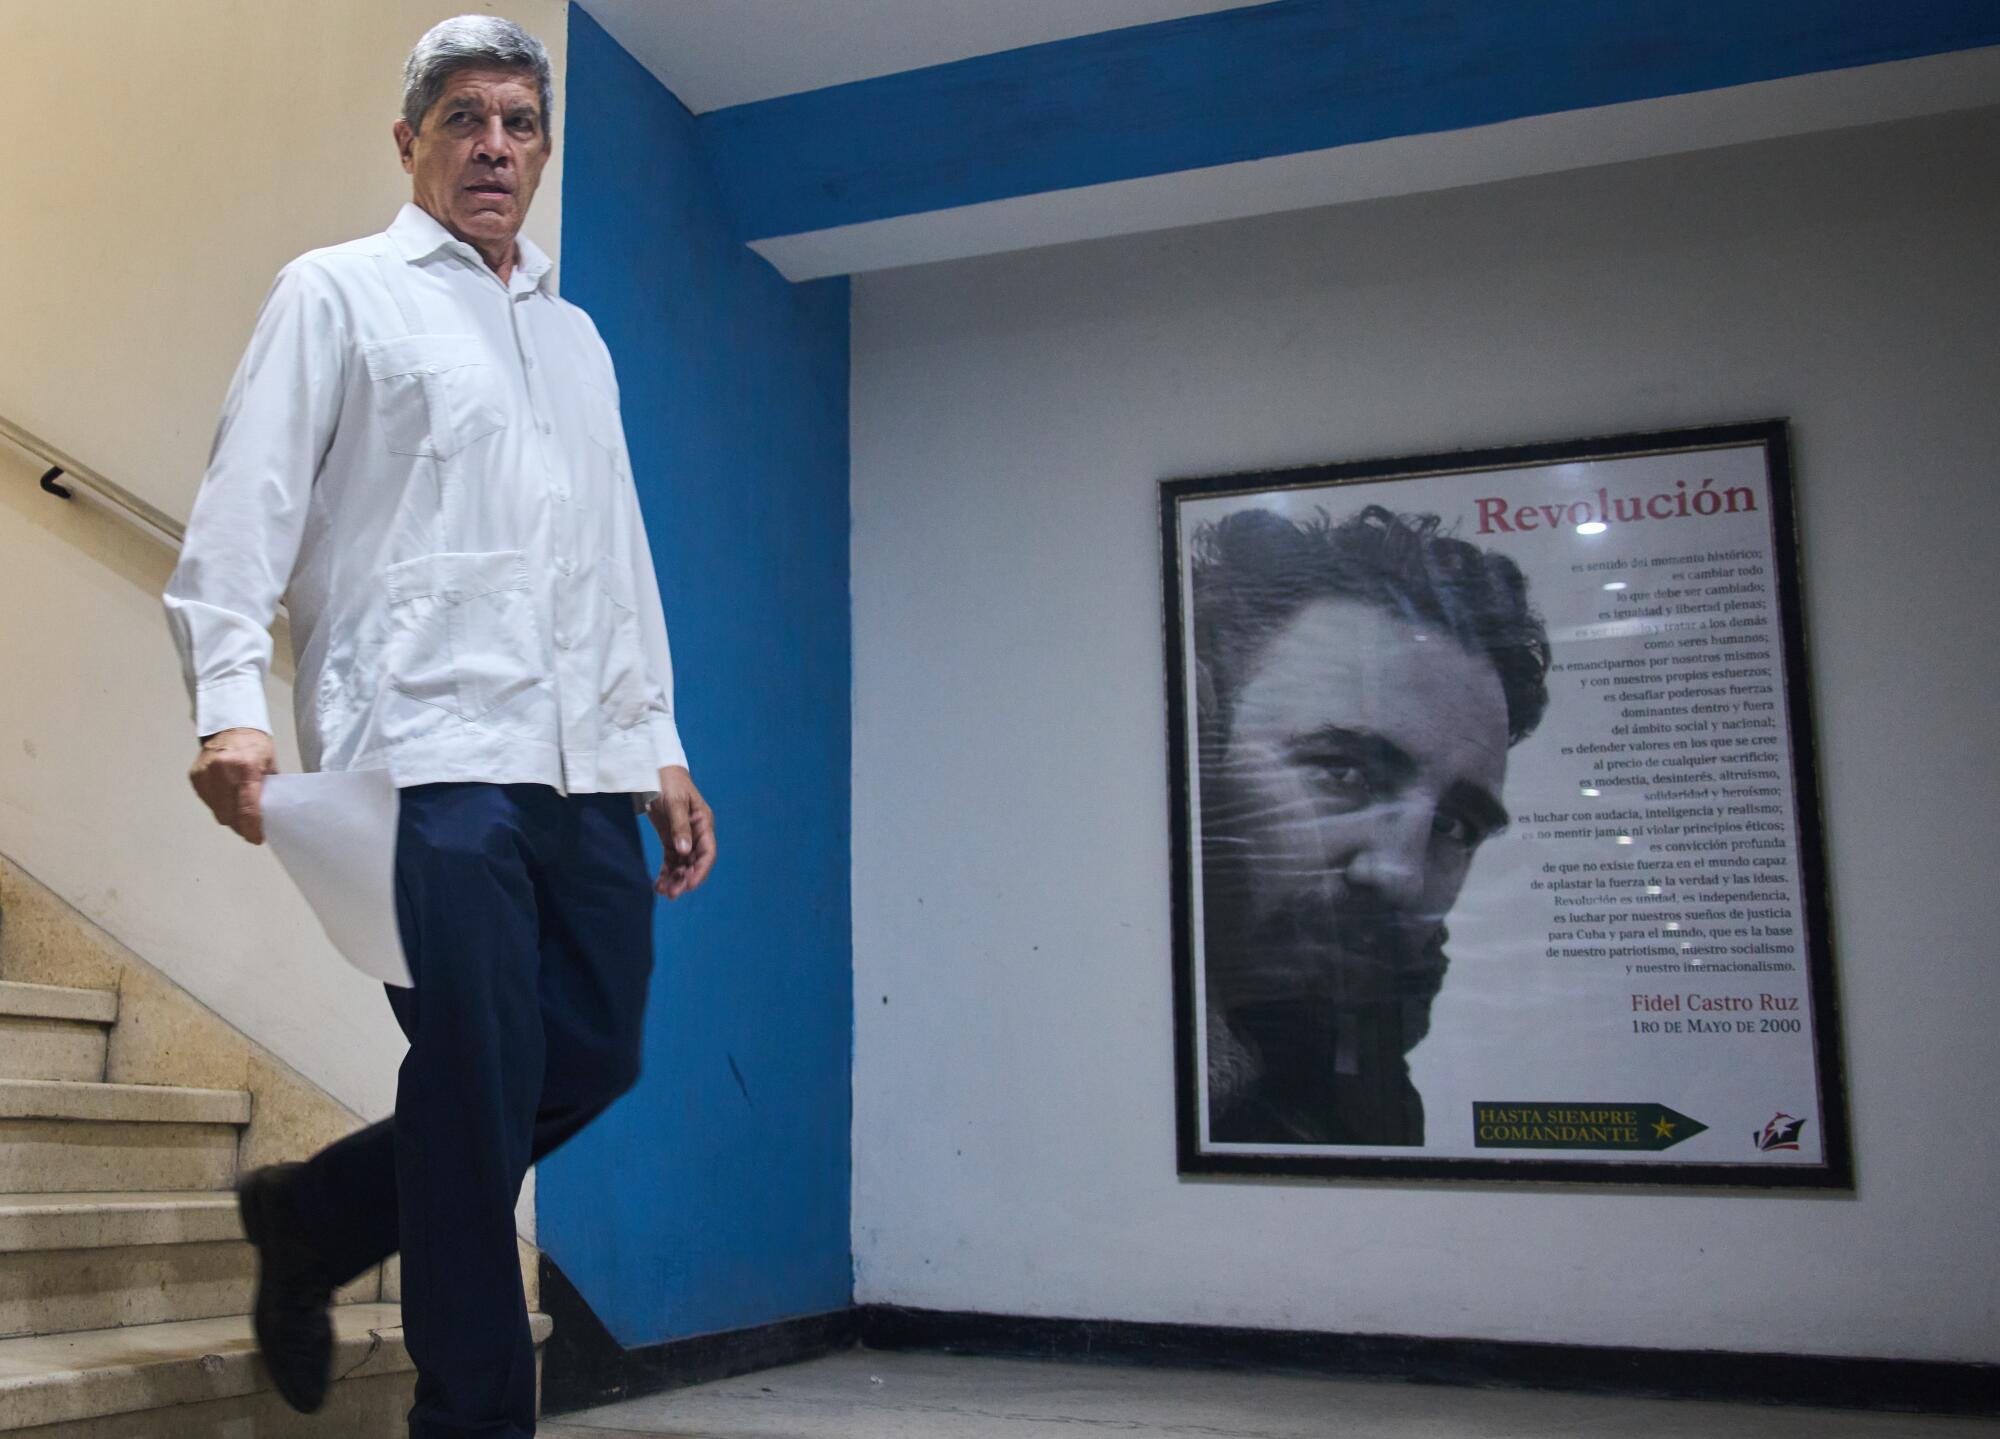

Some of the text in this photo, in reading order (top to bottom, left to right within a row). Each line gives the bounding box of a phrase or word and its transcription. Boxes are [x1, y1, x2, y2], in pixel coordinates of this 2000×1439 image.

[1474, 479, 1757, 535] Revolución
[1570, 549, 1763, 574] es sentido del momento histórico;
[1671, 564, 1764, 581] es cambiar todo
[1616, 581, 1766, 604] lo que debe ser cambiado;
[1597, 599, 1767, 620] es igualdad y libertad plenas;
[1664, 621, 1696, 632] tratar
[1699, 622, 1707, 630] a
[1709, 618, 1727, 630] los
[1728, 614, 1768, 628] demás
[1643, 633, 1769, 651] como seres humanos;
[1550, 650, 1771, 673] es emanciparnos por nosotros mismos
[1580, 667, 1772, 690] y con nuestros propios esfuerzos;
[1602, 683, 1774, 703] es desafiar poderosas fuerzas
[1620, 700, 1775, 719] dominantes dentro y fuera
[1610, 716, 1777, 736] del ámbito social y nacional;
[1560, 736, 1777, 755] es defender valores en los que se cree
[1593, 751, 1779, 773] al precio de cualquier sacrificio;
[1578, 778, 1593, 788] es
[1594, 774, 1651, 788] modestia,
[1644, 787, 1709, 801] solidaridad
[1711, 789, 1719, 797] y
[1517, 802, 1783, 824] es luchar con audacia, inteligencia y realismo;
[1537, 831, 1551, 839] no
[1553, 827, 1593, 839] mentir
[1594, 826, 1630, 840] jamás
[1631, 825, 1644, 837] ni
[1646, 823, 1681, 835] violar
[1682, 821, 1743, 837] principios
[1744, 820, 1785, 832] éticos;
[1649, 836, 1786, 853] es convicción profunda
[1541, 855, 1787, 875] de que no existe fuerza en el mundo capaz
[1530, 872, 1789, 891] de aplastar la fuerza de la verdad y las ideas.
[1554, 894, 1617, 907] Revolución
[1619, 896, 1633, 904] es
[1682, 894, 1696, 902] es
[1698, 889, 1791, 905] independencia,
[1553, 907, 1792, 925] es luchar por nuestros sueños de justicia
[1547, 925, 1793, 942] para Cuba y para el mundo, que es la base
[1545, 943, 1795, 959] de nuestro patriotismo, nuestro socialismo
[1625, 960, 1796, 976] y nuestro internacionalismo.
[1631, 993, 1799, 1011] Fidel Castro Ruz
[1760, 1018, 1801, 1033] 2000
[1479, 1109, 1638, 1126] HASTA SIEMPRE
[1479, 1125, 1639, 1143] COMANDANTE
